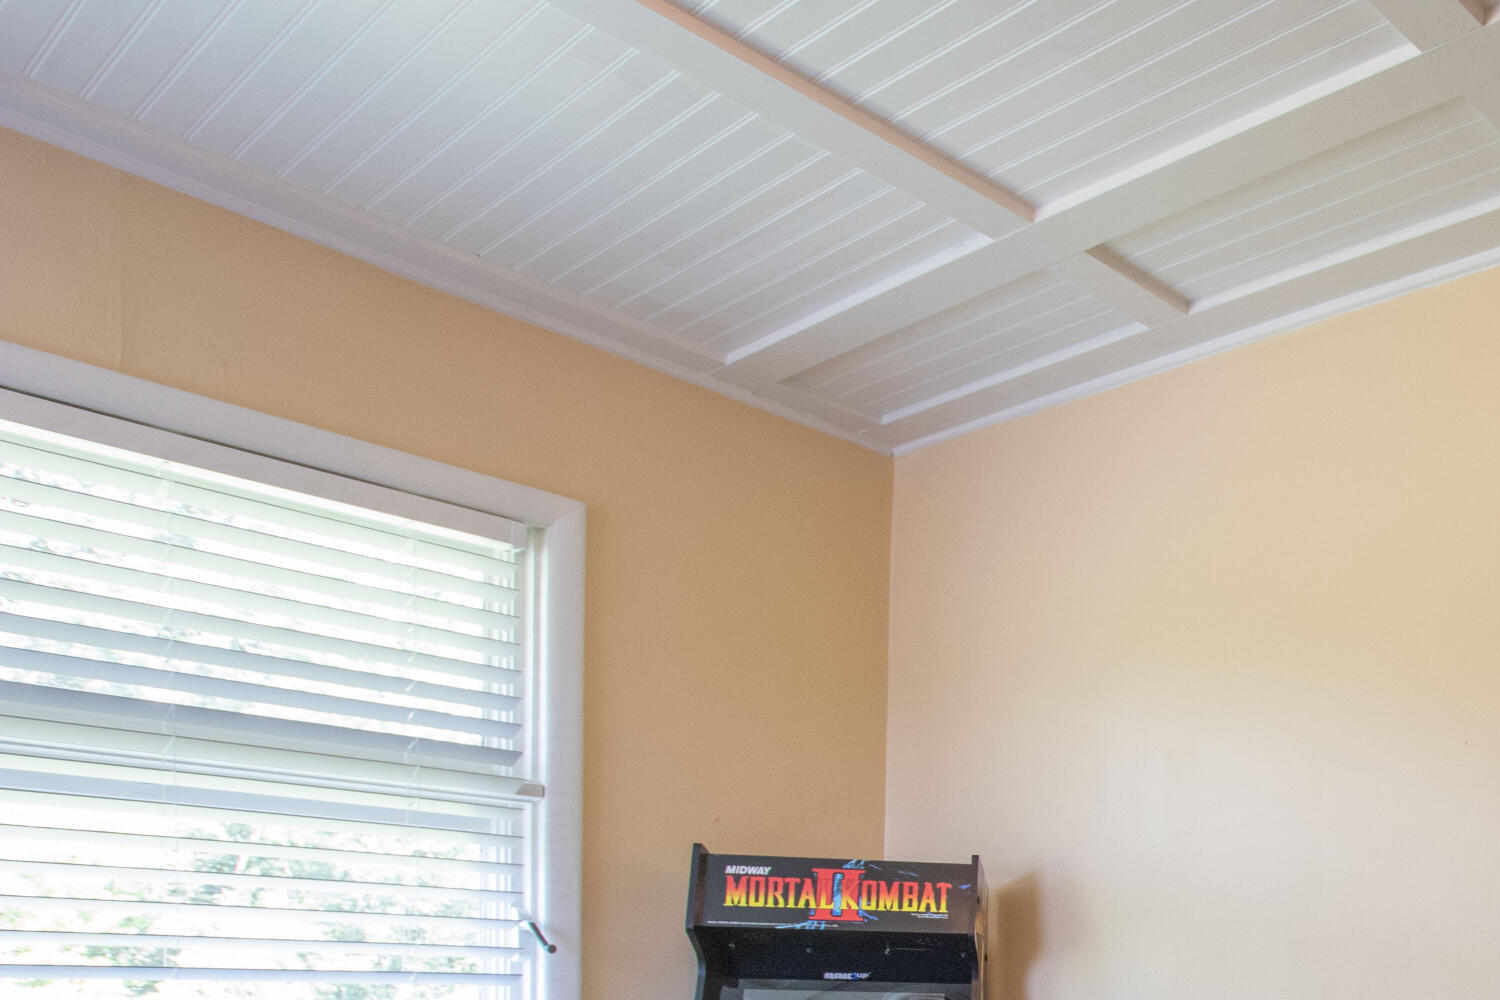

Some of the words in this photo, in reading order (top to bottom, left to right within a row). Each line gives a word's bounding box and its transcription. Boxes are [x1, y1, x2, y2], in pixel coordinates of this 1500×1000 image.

[724, 865, 772, 876] MIDWAY
[723, 875, 834, 909] MORTAL
[839, 879, 953, 913] KOMBAT
